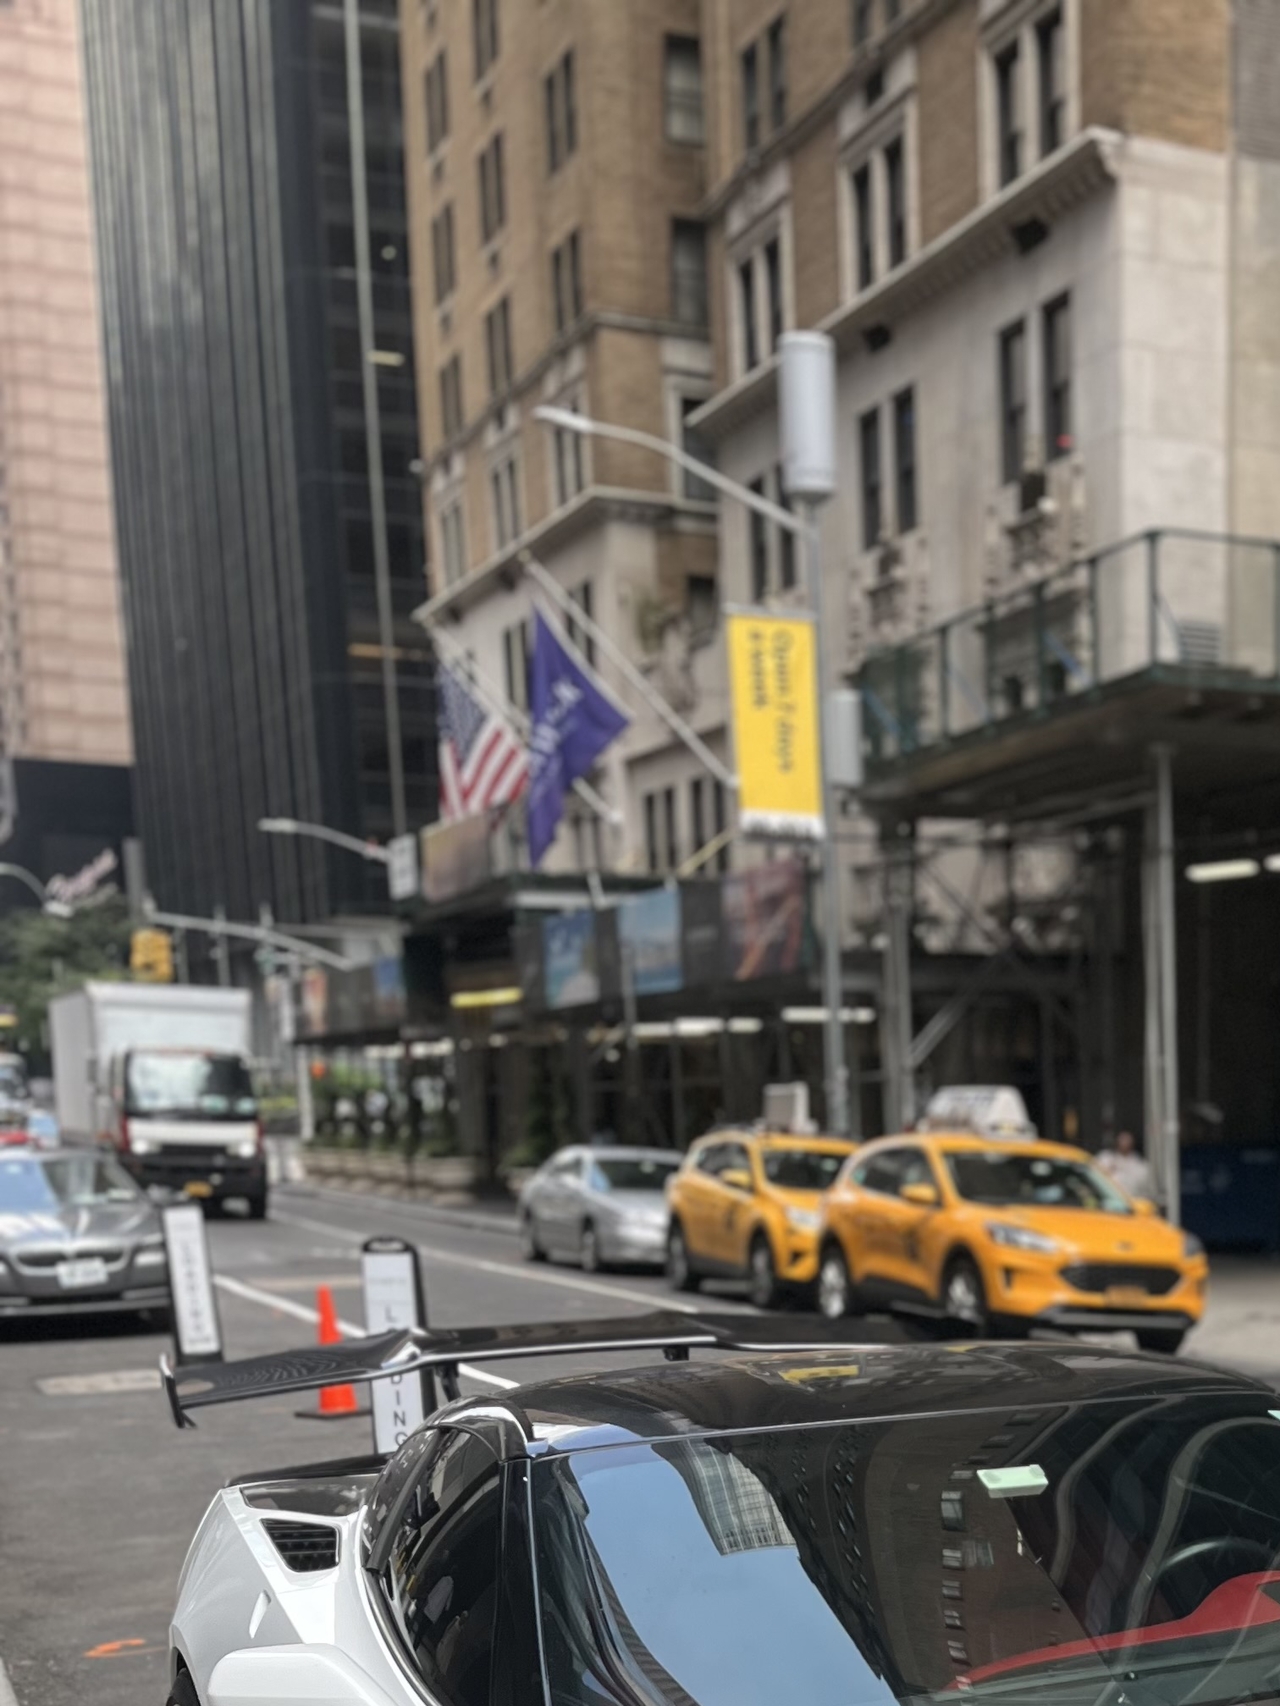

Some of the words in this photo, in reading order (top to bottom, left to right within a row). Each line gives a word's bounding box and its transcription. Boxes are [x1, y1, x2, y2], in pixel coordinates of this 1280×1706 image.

[772, 629, 794, 696] Open
[775, 718, 796, 773] days
[384, 1304, 408, 1448] LDING
